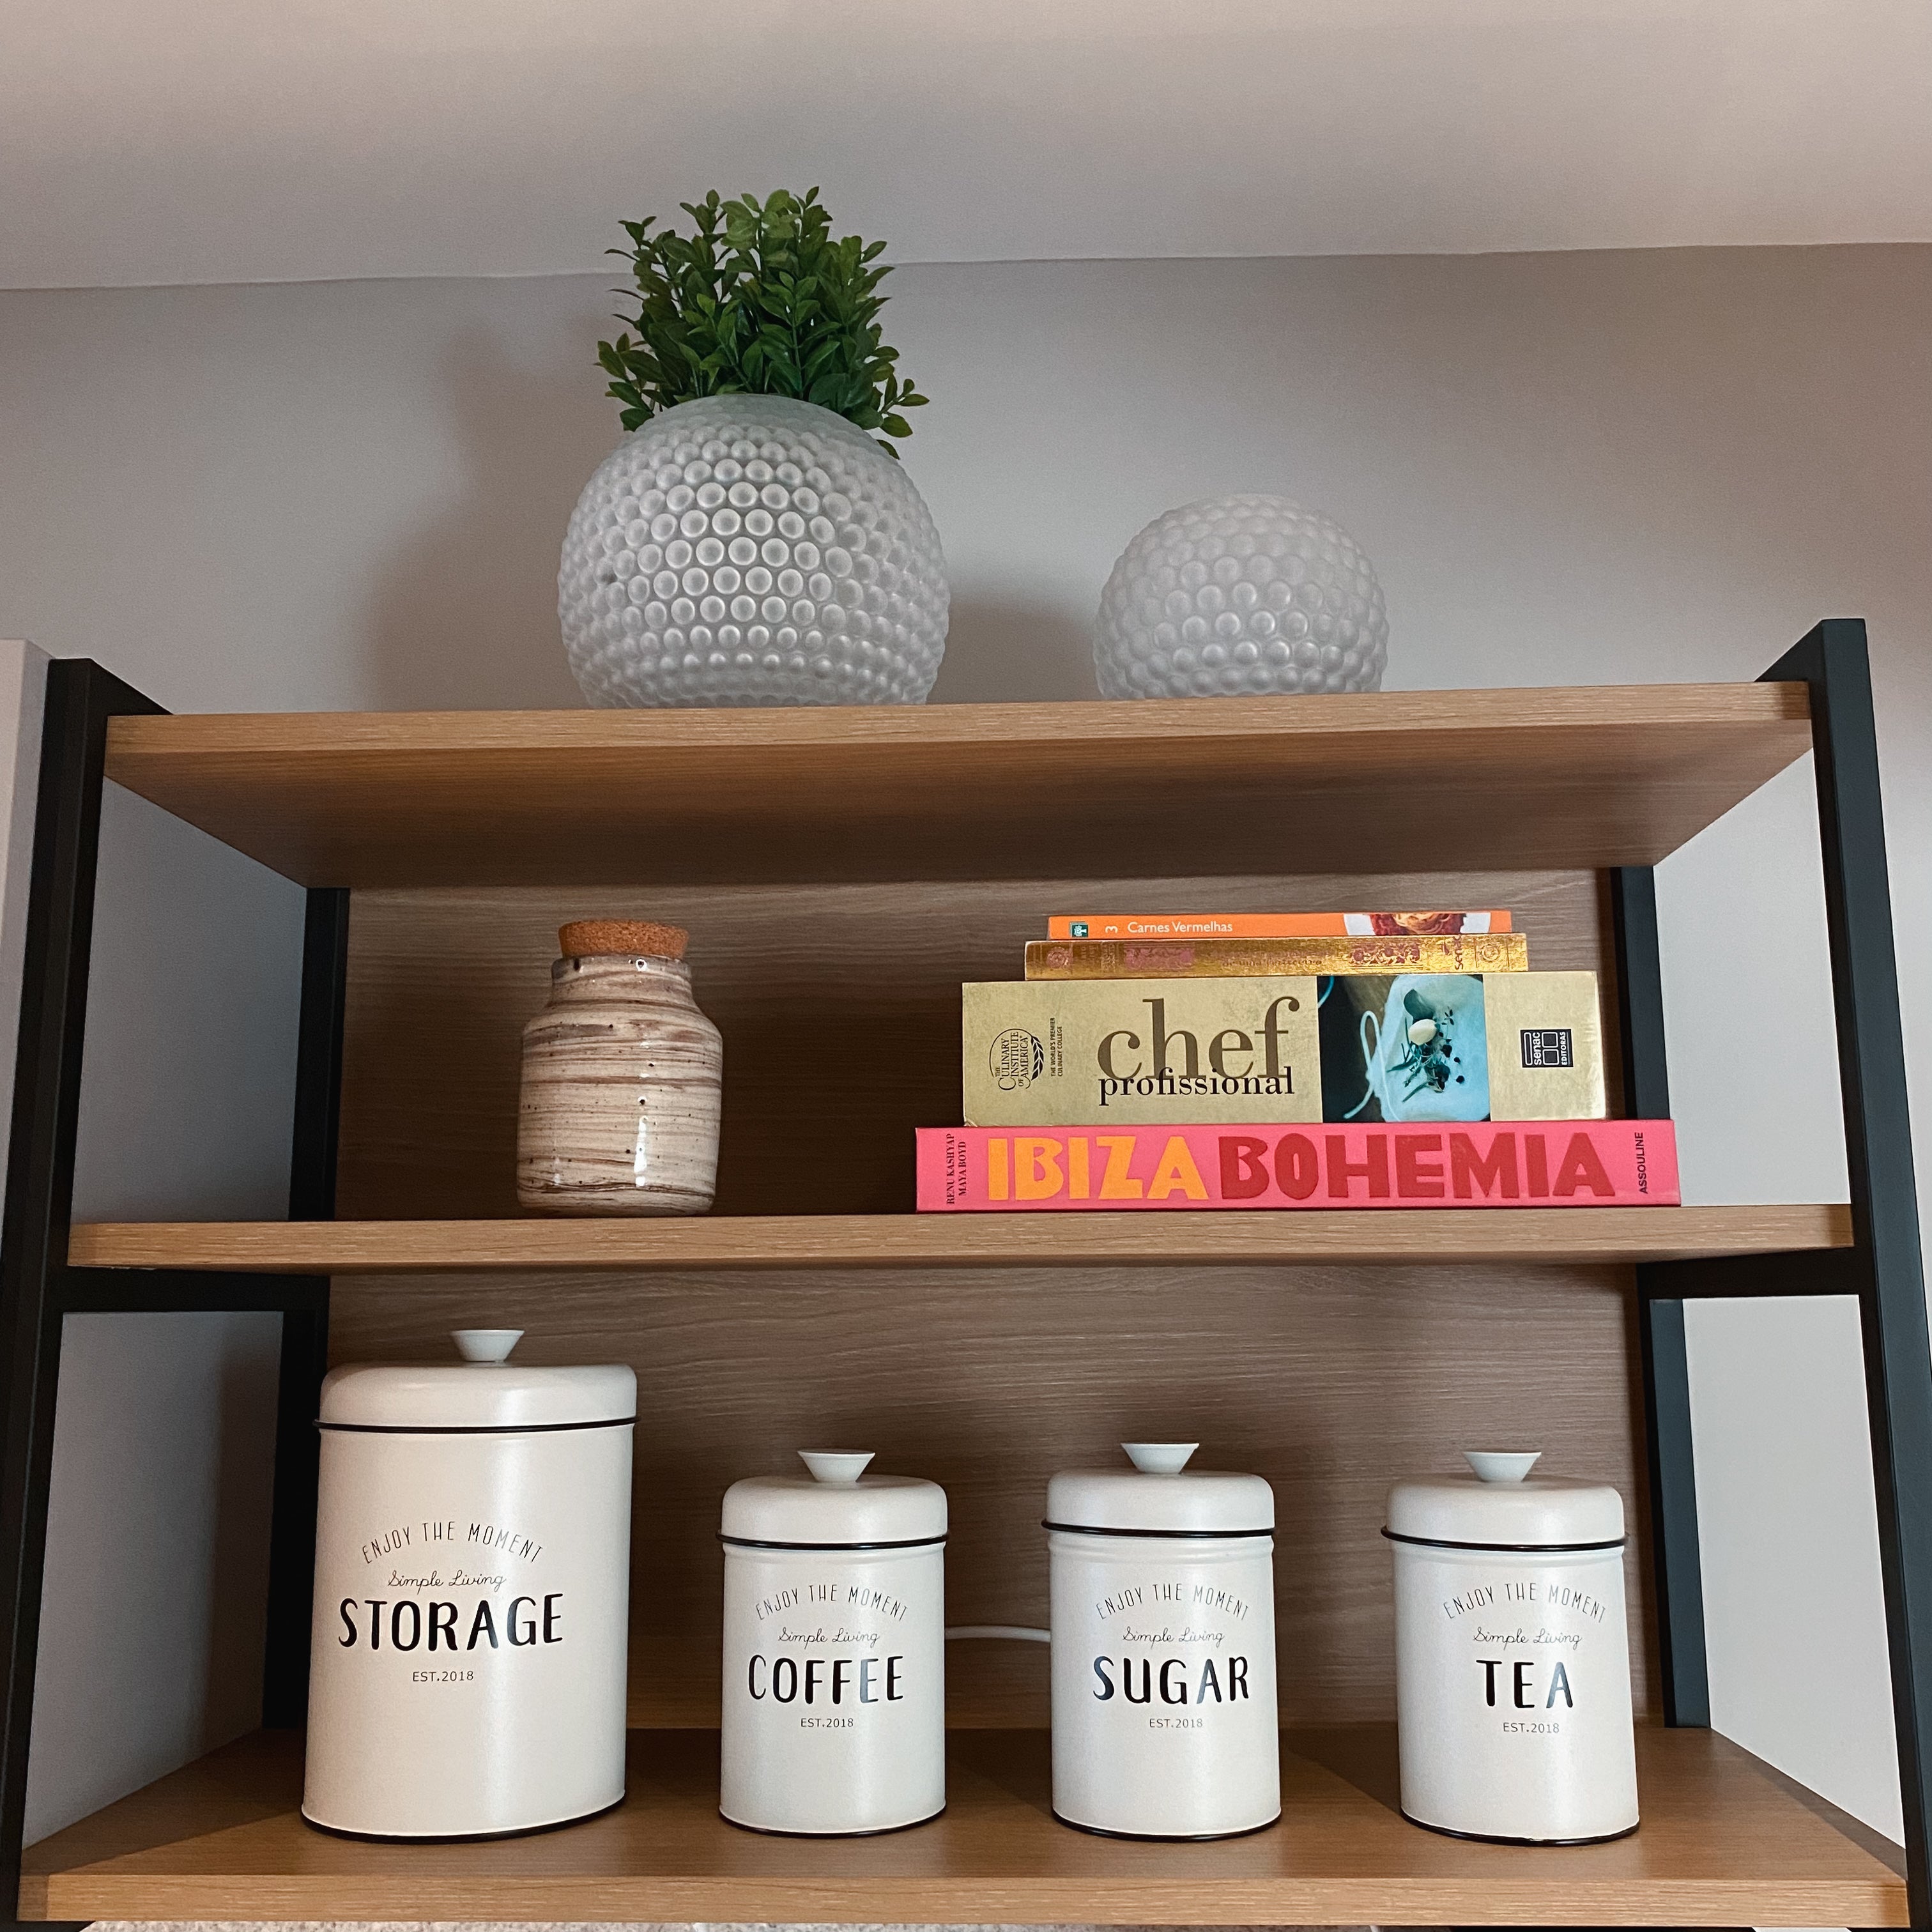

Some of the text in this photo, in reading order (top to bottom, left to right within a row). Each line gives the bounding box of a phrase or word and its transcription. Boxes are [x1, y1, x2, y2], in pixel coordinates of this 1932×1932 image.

[1127, 921, 1232, 933] Carnes Vermelhas
[1010, 1031, 1019, 1077] INSTITUTE
[1097, 996, 1300, 1080] chef
[1532, 1032, 1542, 1066] senac
[1560, 1031, 1568, 1066] EDITORAS
[1098, 1066, 1295, 1106] profissional
[946, 1133, 955, 1204] RENU KASHYAP
[958, 1141, 967, 1196] MAYA BOYD
[988, 1133, 1616, 1200] IBIZA BOHEMIA
[1634, 1131, 1648, 1194] ASSOULINE
[362, 1521, 543, 1564] ENJOY THE MOMENT
[387, 1569, 506, 1594] Simple Living
[756, 1584, 908, 1621] ENJOY THE MOMENT
[1096, 1583, 1249, 1621] ENJOY THE MOMENT
[1443, 1583, 1606, 1623] ENJOY THE MOMENT
[339, 1593, 563, 1652] STORAGE
[778, 1627, 880, 1650] Simple Living
[1123, 1626, 1225, 1650] Simple Living
[1473, 1627, 1583, 1650] Simple Living
[412, 1671, 474, 1682] EST.2018
[748, 1654, 903, 1705] COFFEE
[1093, 1656, 1249, 1705] SUGAR
[1476, 1660, 1574, 1708] TEA
[801, 1718, 854, 1728] EST.2018
[1149, 1719, 1203, 1728] EST.2018
[1503, 1722, 1560, 1733] EST.2018
